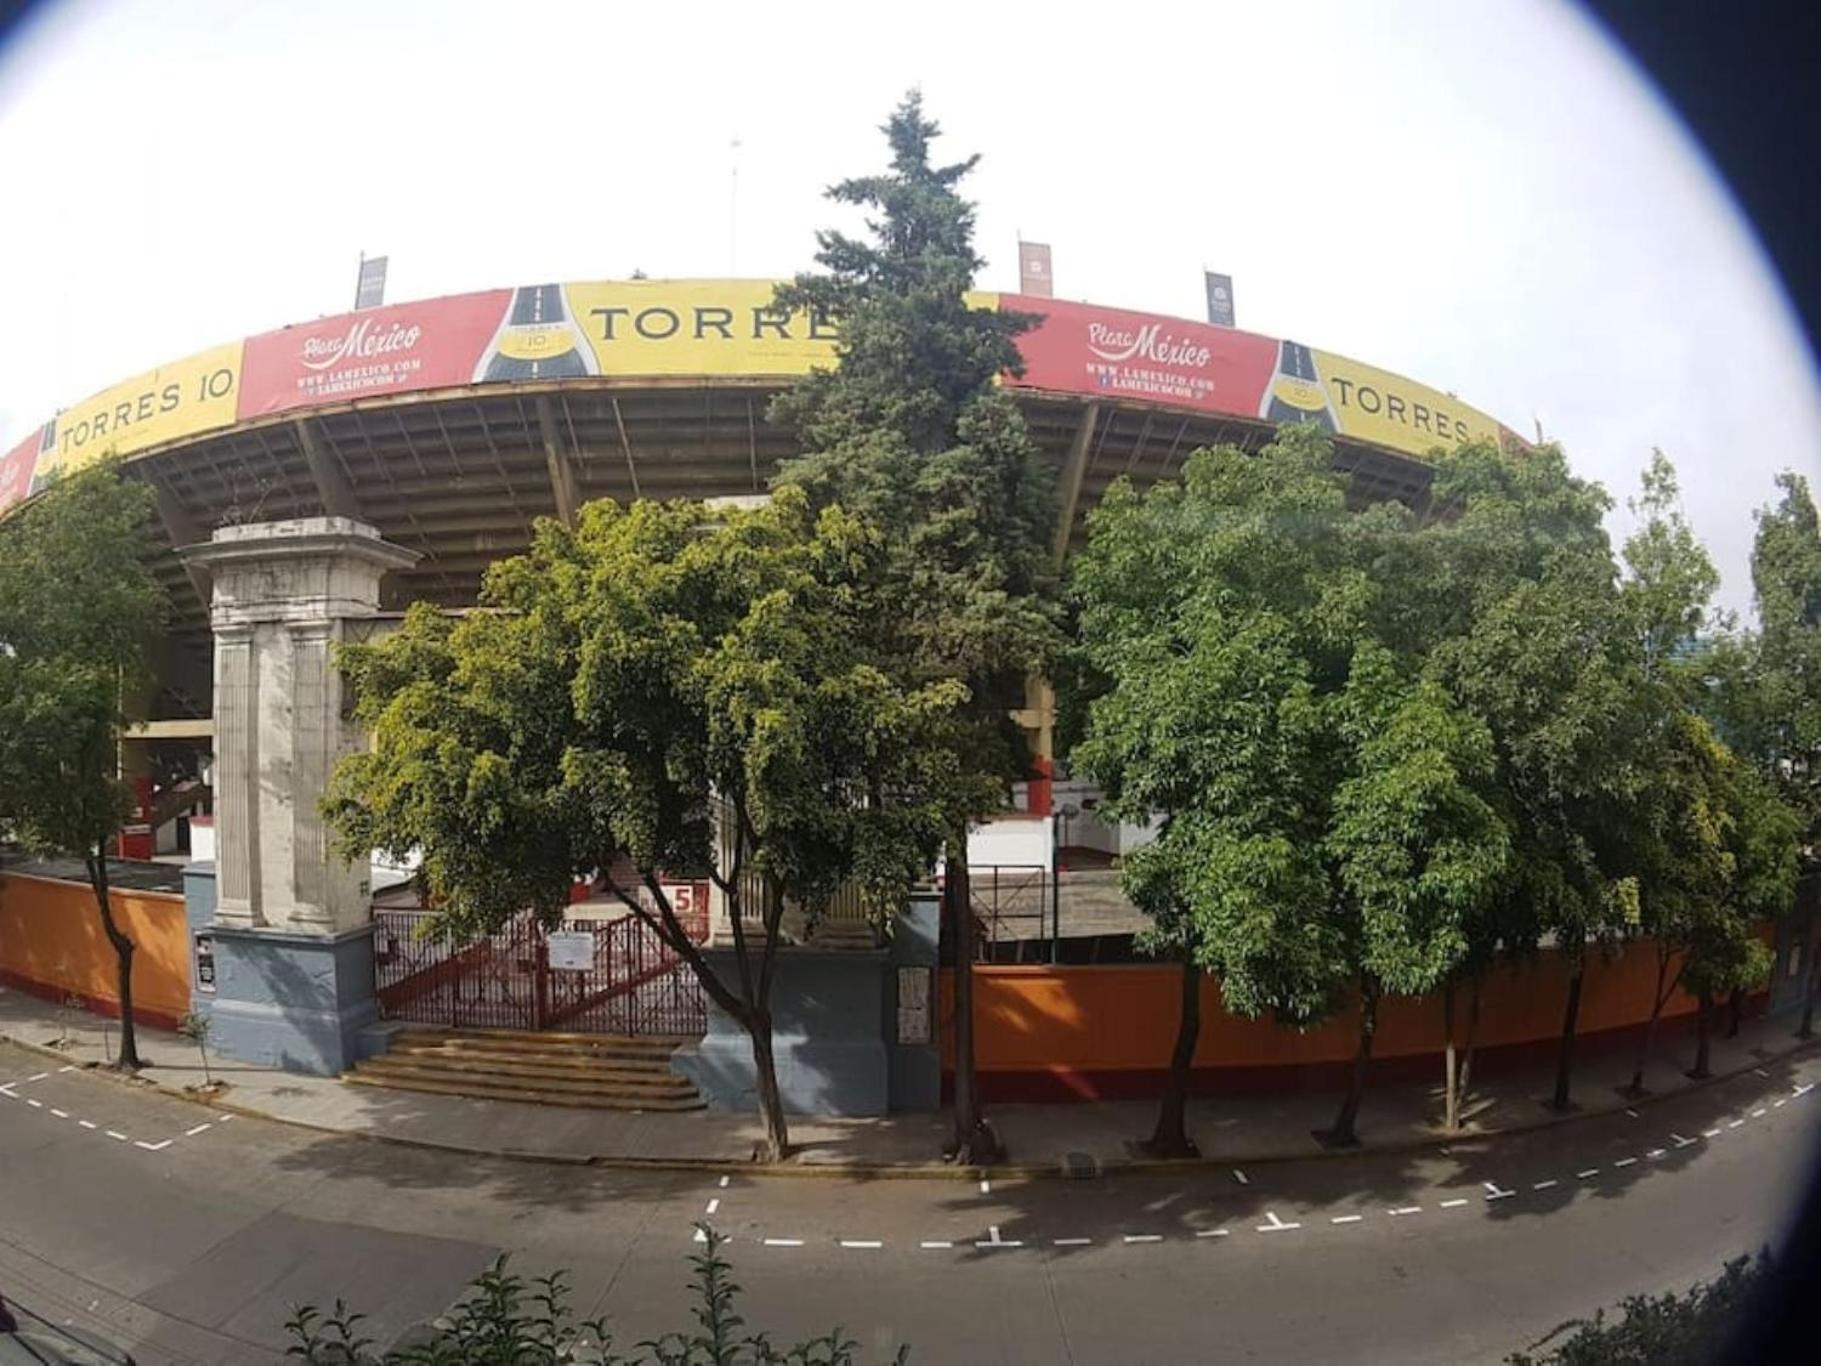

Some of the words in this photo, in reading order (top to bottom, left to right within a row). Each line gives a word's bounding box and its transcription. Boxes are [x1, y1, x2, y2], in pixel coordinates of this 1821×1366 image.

[339, 318, 421, 358] México
[590, 306, 842, 341] TORRE
[1087, 322, 1135, 347] Plaza
[1130, 323, 1212, 368] México
[62, 383, 181, 454] TORRES
[201, 368, 234, 402] 10
[1331, 376, 1471, 446] TORRES
[675, 888, 691, 911] 5
